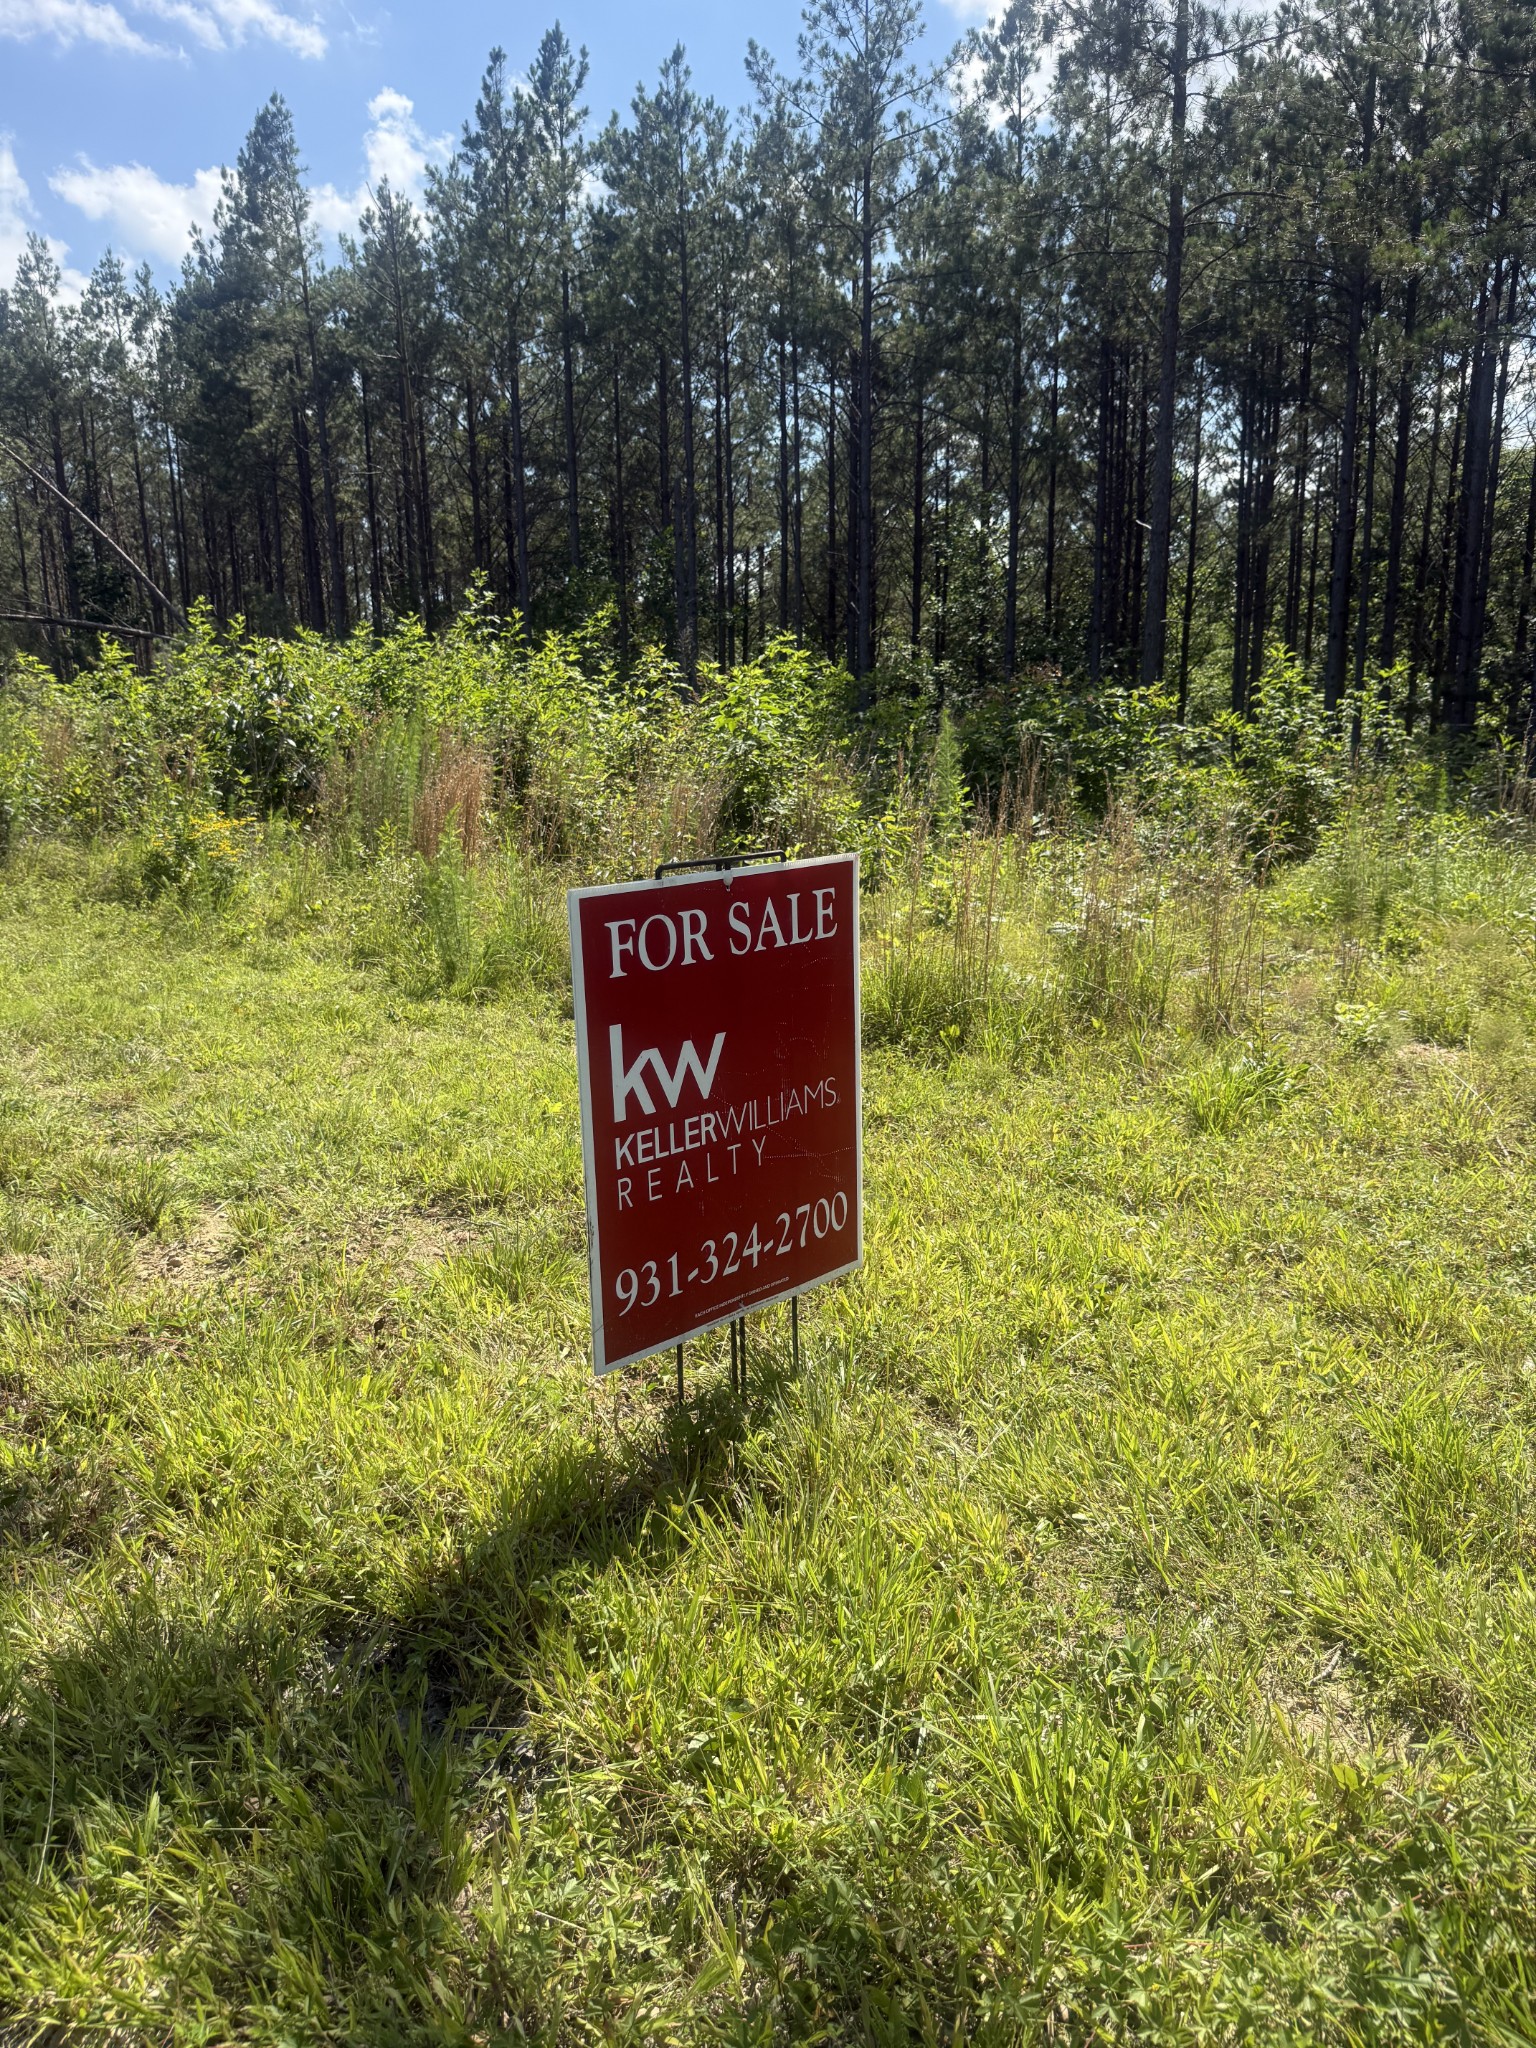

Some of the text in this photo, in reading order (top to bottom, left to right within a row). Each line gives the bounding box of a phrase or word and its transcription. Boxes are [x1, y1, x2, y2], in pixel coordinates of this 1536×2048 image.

[604, 887, 838, 979] FOR SALE
[609, 1023, 726, 1123] kw
[617, 1135, 767, 1211] REALTY
[615, 1191, 848, 1317] 931-324-2700
